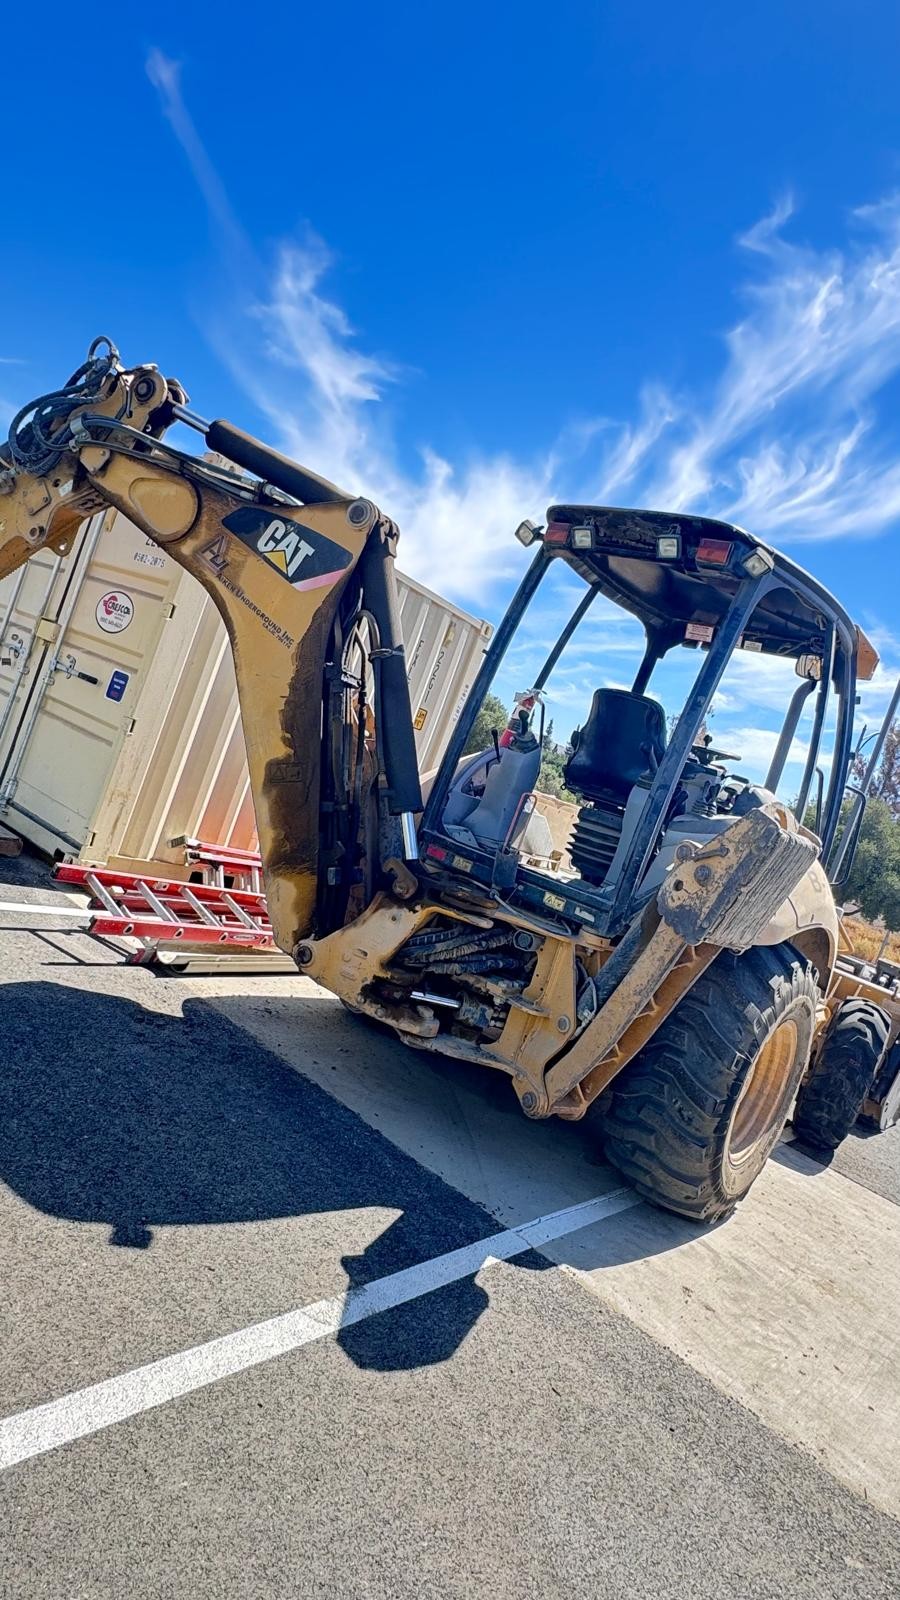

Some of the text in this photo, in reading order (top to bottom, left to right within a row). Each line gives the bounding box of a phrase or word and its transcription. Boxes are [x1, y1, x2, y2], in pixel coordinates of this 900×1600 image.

[257, 520, 315, 577] CAT
[215, 572, 295, 645] AIKEN UNDERGROUND INC
